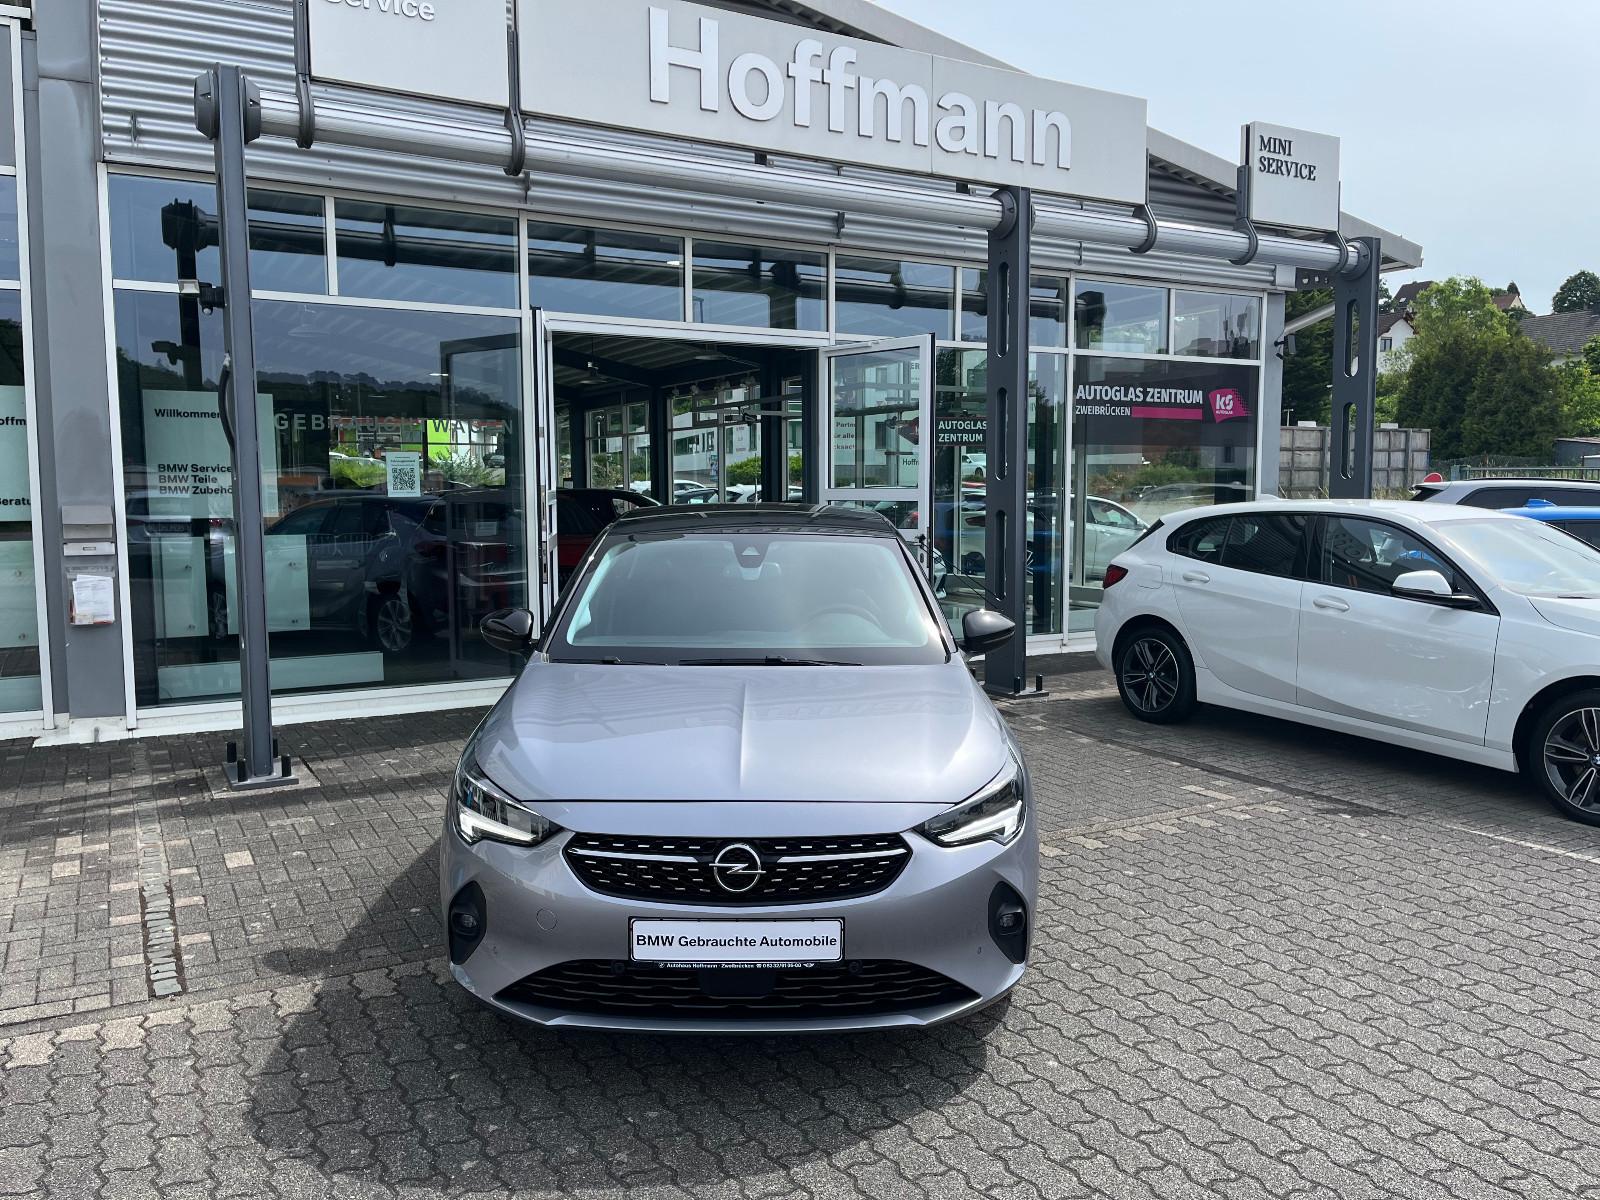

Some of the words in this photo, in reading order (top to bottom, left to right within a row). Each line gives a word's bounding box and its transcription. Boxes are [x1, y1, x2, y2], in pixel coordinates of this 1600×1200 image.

[648, 6, 1072, 169] Hoffmann
[1259, 135, 1293, 156] MINI
[1259, 156, 1317, 181] SERVICE
[1075, 384, 1144, 402] AUTOGLAS
[1146, 387, 1203, 405] ZENTRUM
[1075, 404, 1131, 416] ZWEIBRÜCKEN
[938, 420, 987, 431] AUTOGLAS
[938, 433, 983, 443] ZENTRUM
[158, 463, 188, 472] BMW
[191, 463, 232, 473] Service
[158, 474, 189, 484] BMW
[191, 474, 218, 484] Teile
[159, 485, 190, 494] BMW
[0, 497, 31, 506] eratu
[636, 934, 675, 947] BMW
[678, 935, 757, 947] Gebrauchte
[760, 935, 837, 947] Automobile
